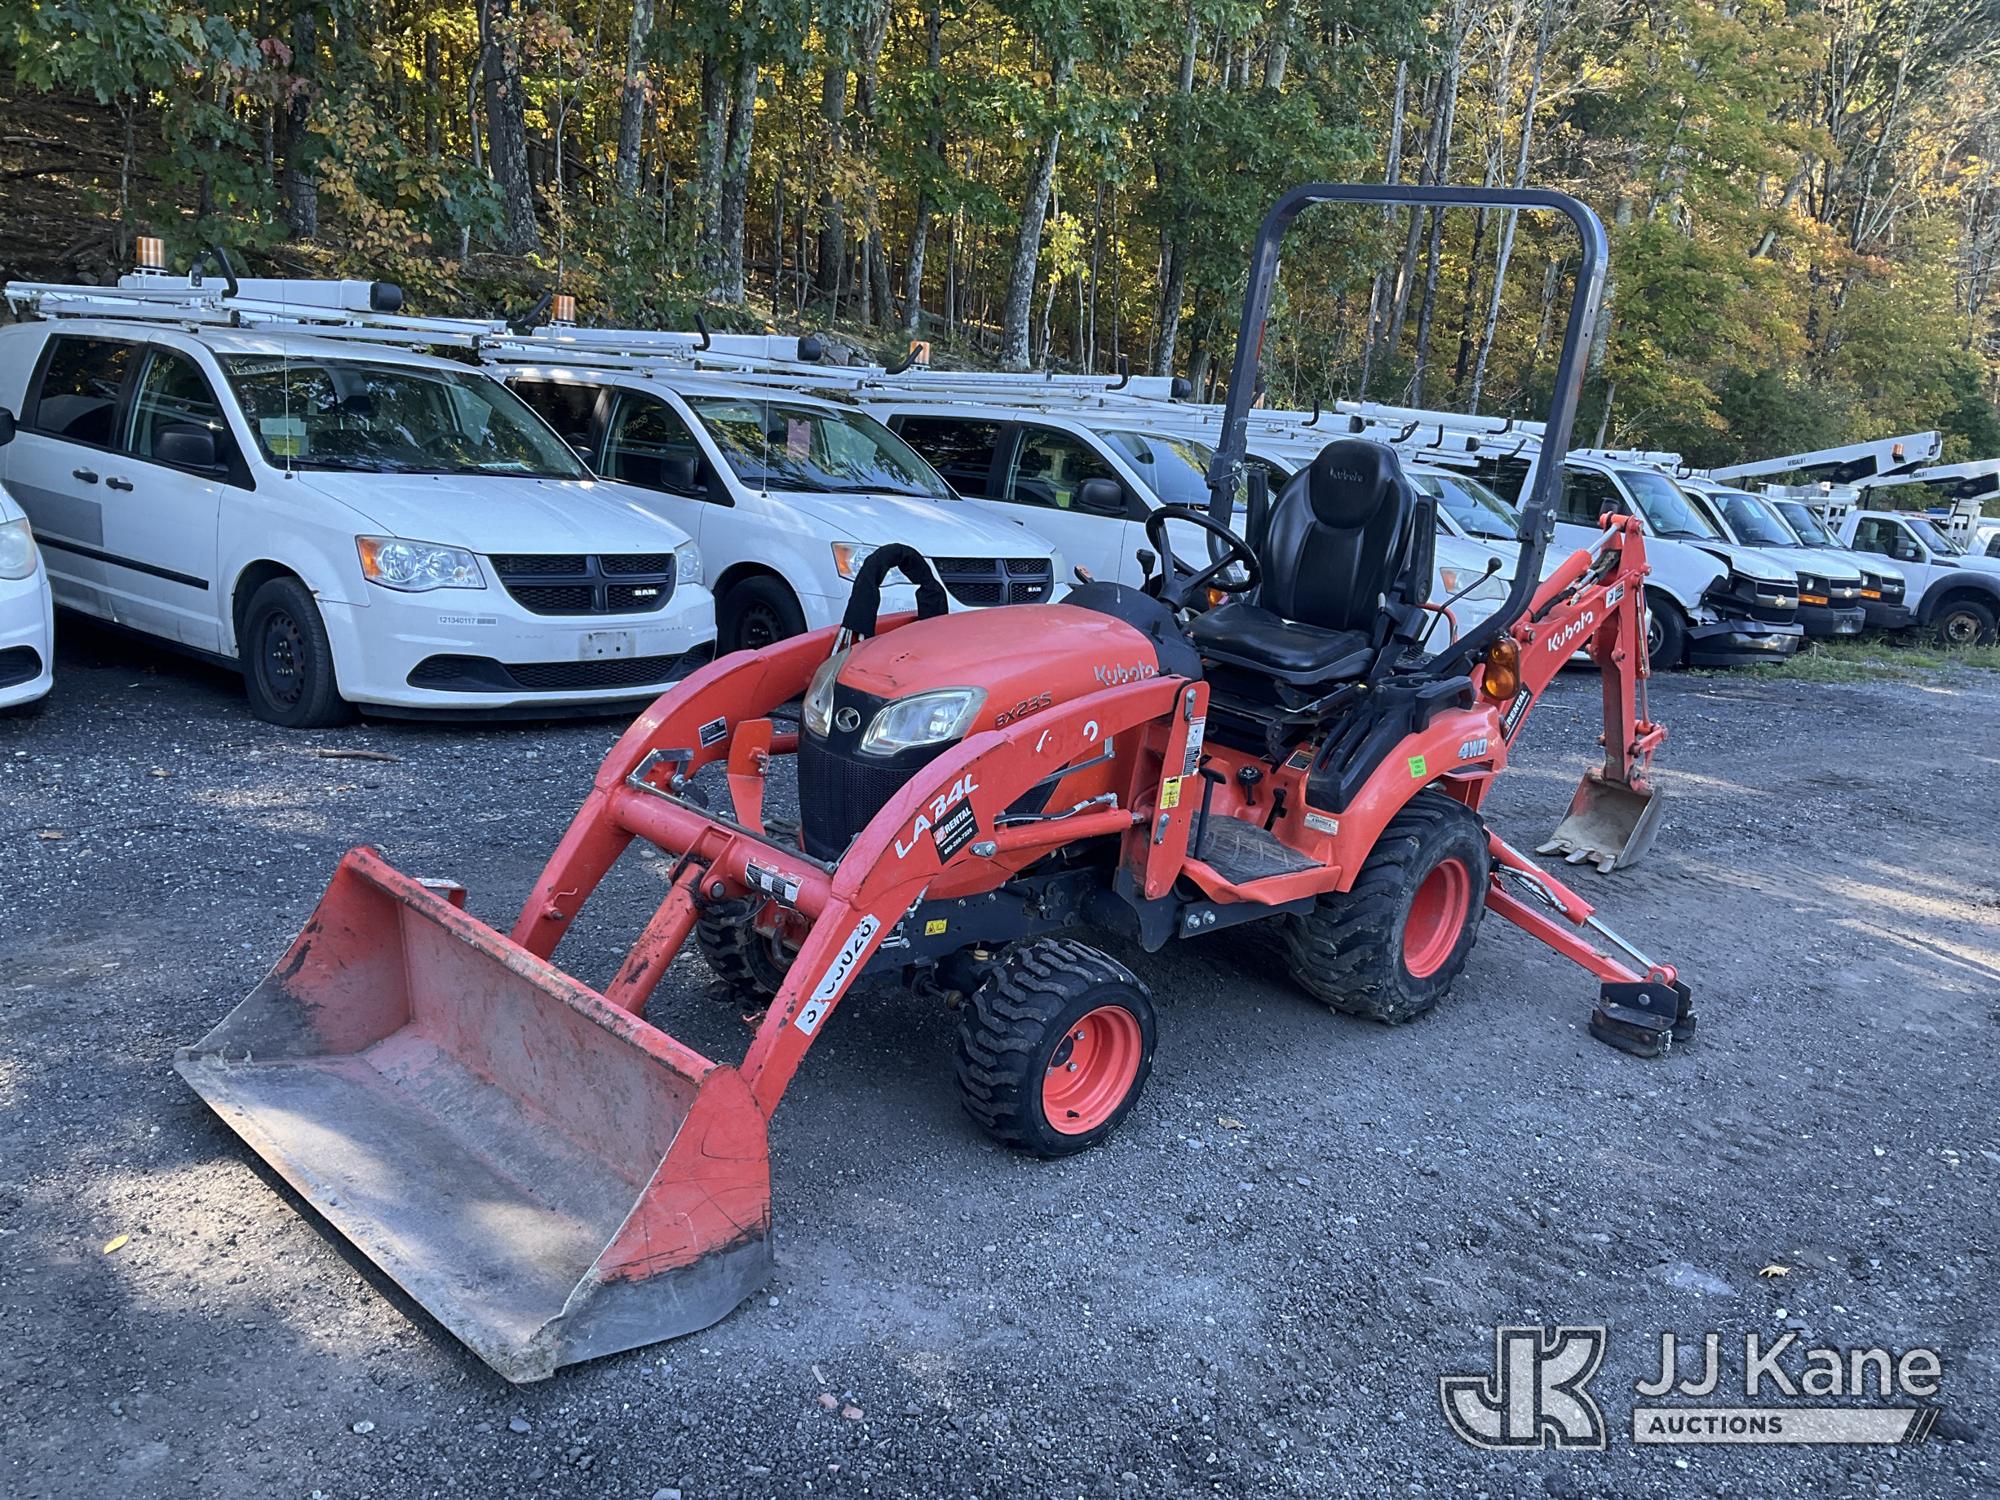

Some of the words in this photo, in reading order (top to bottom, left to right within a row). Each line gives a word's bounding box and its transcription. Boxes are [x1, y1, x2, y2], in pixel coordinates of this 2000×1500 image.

[633, 588, 658, 596] RAM
[1546, 610, 1594, 652] Kubota
[1093, 660, 1156, 686] Kubota
[995, 690, 1053, 727] BX23S
[1505, 689, 1528, 726] RENTAL
[1457, 738, 1488, 760] 4WD
[944, 806, 972, 834] RENTAL
